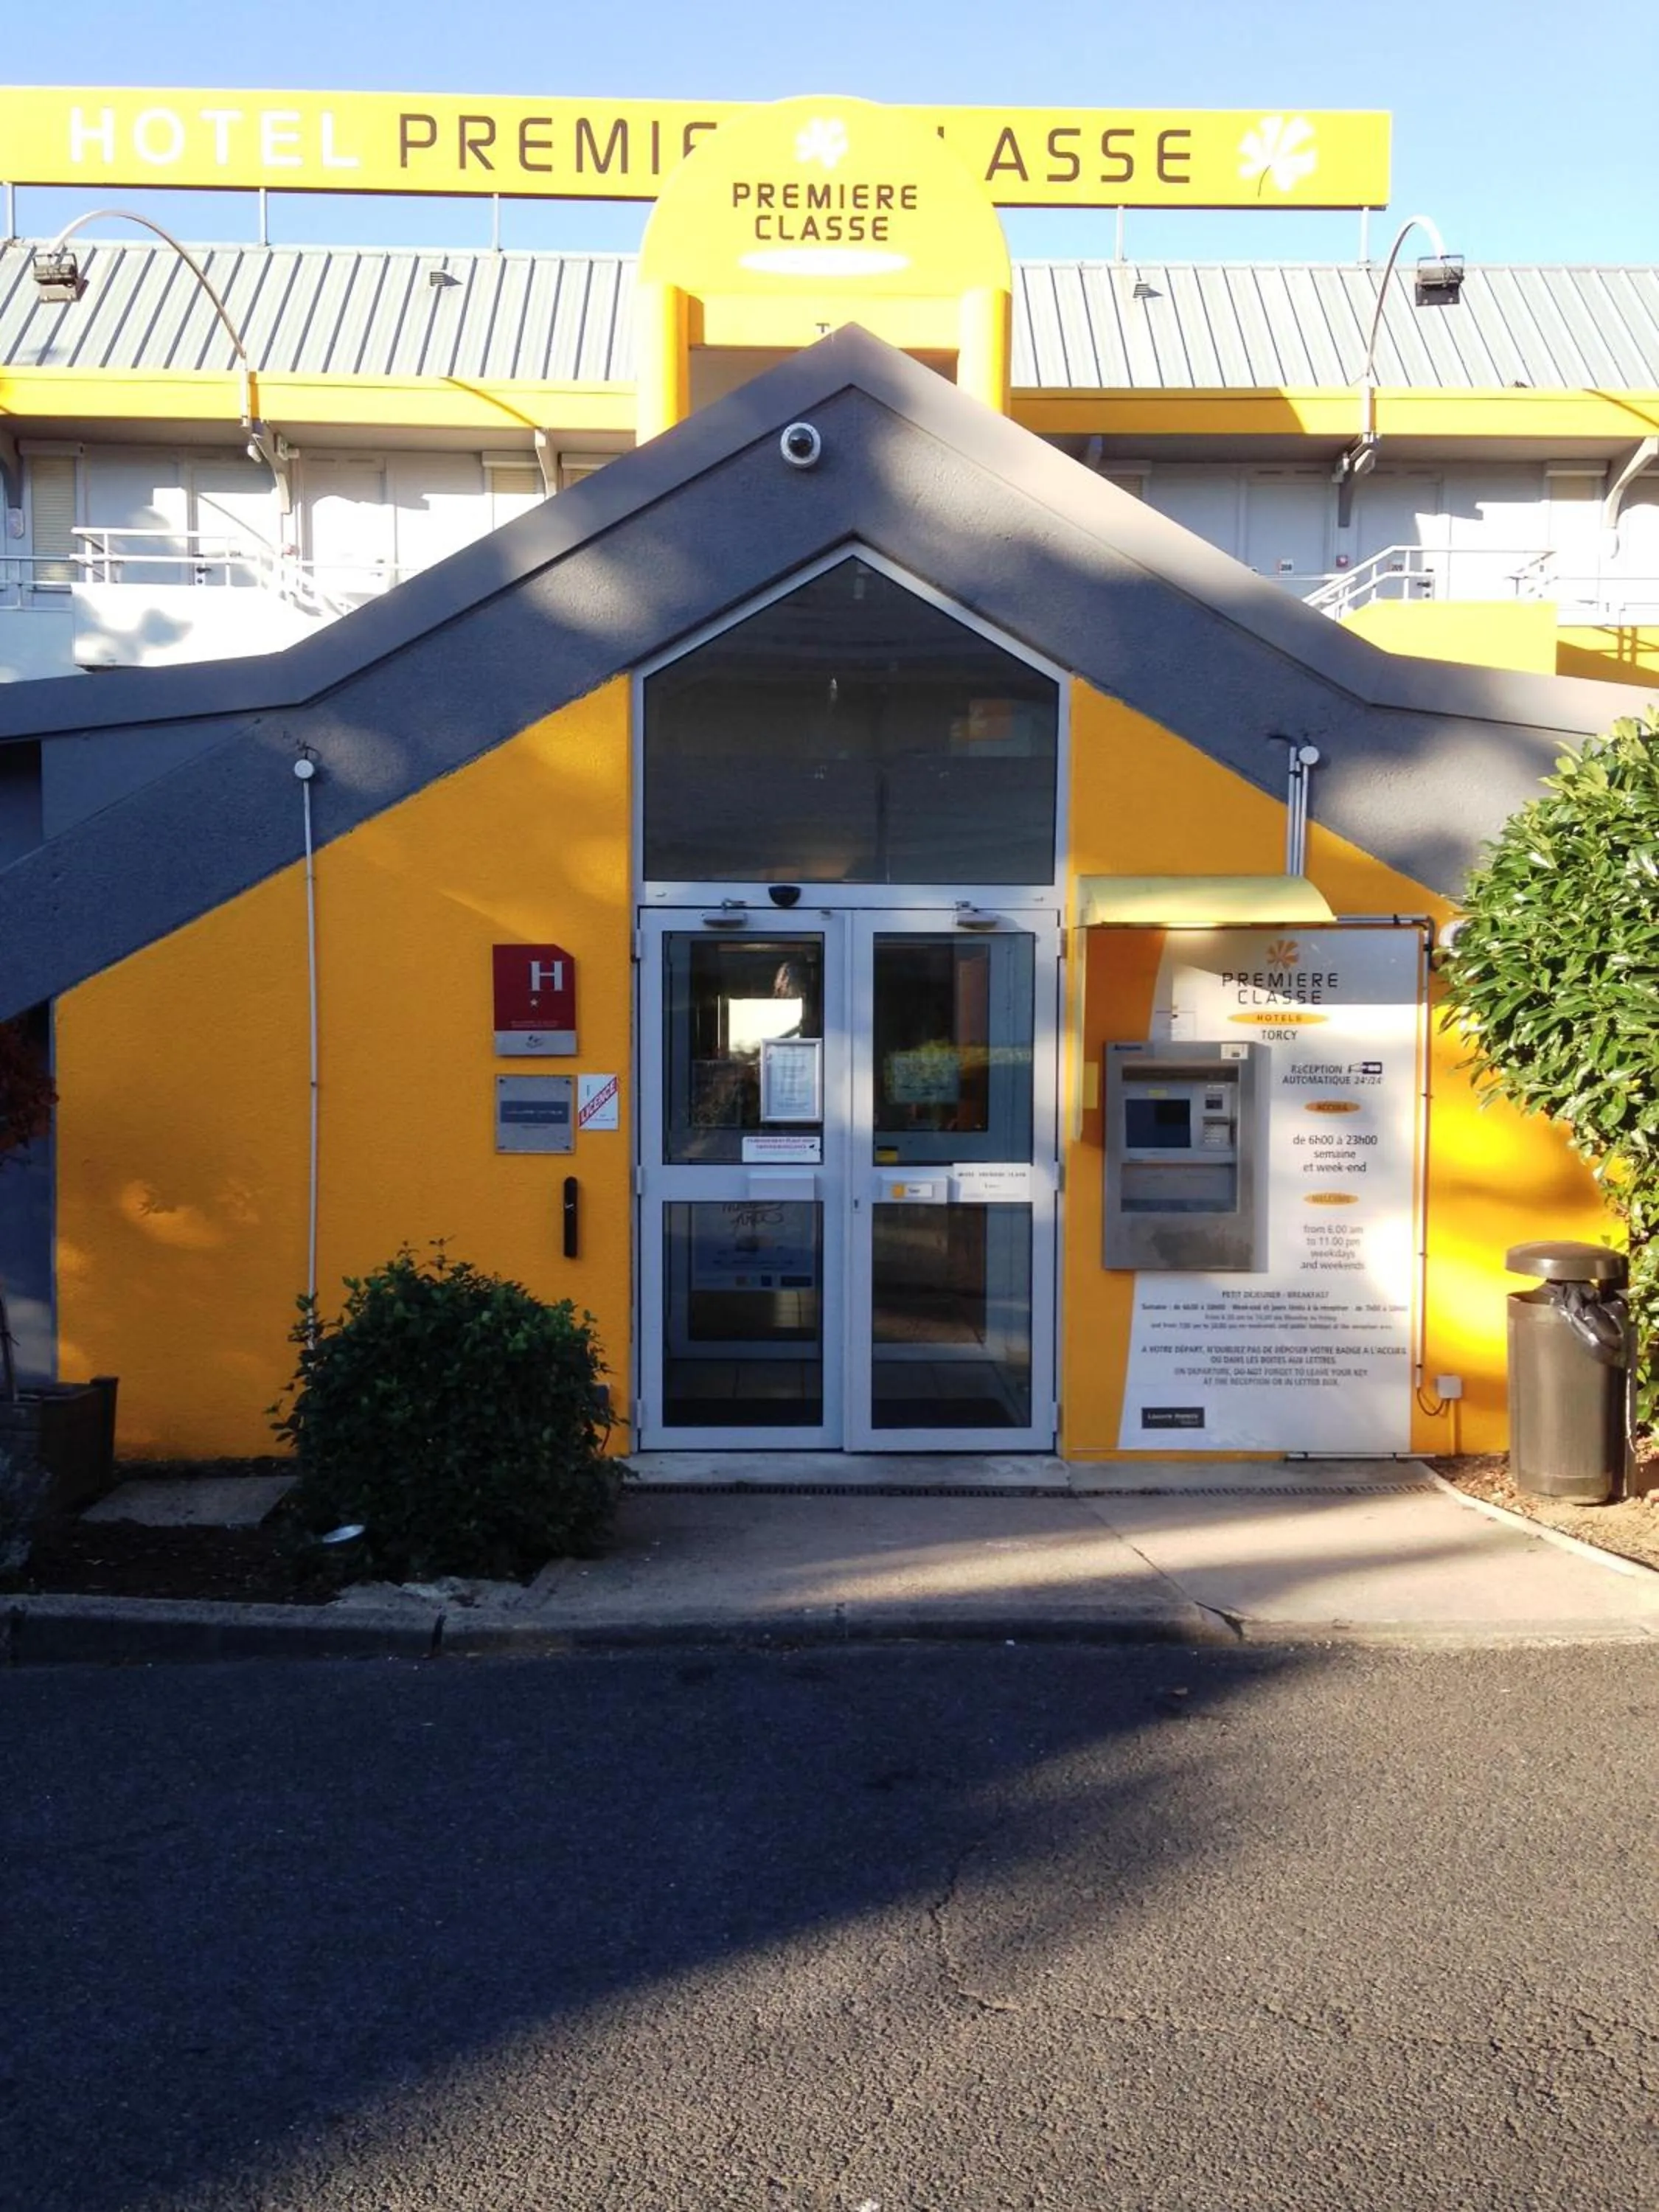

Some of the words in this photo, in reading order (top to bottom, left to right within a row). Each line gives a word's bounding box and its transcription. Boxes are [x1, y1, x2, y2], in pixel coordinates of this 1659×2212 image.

[69, 106, 361, 167] HOTEL
[732, 182, 918, 210] PREMIERE
[754, 215, 888, 241] CLASSE
[528, 960, 566, 992] H
[1222, 973, 1338, 987] PREMIERE
[1238, 990, 1322, 1004] CLASSE
[1262, 1029, 1298, 1040] TORCY
[1282, 1076, 1351, 1085] AUTOMATIQUE
[1293, 1135, 1307, 1145] de
[1309, 1135, 1334, 1145] 6h00
[1346, 1135, 1378, 1145] 23h00
[1313, 1150, 1356, 1158] semaine
[1303, 1163, 1314, 1172] et
[1304, 1225, 1326, 1234] from
